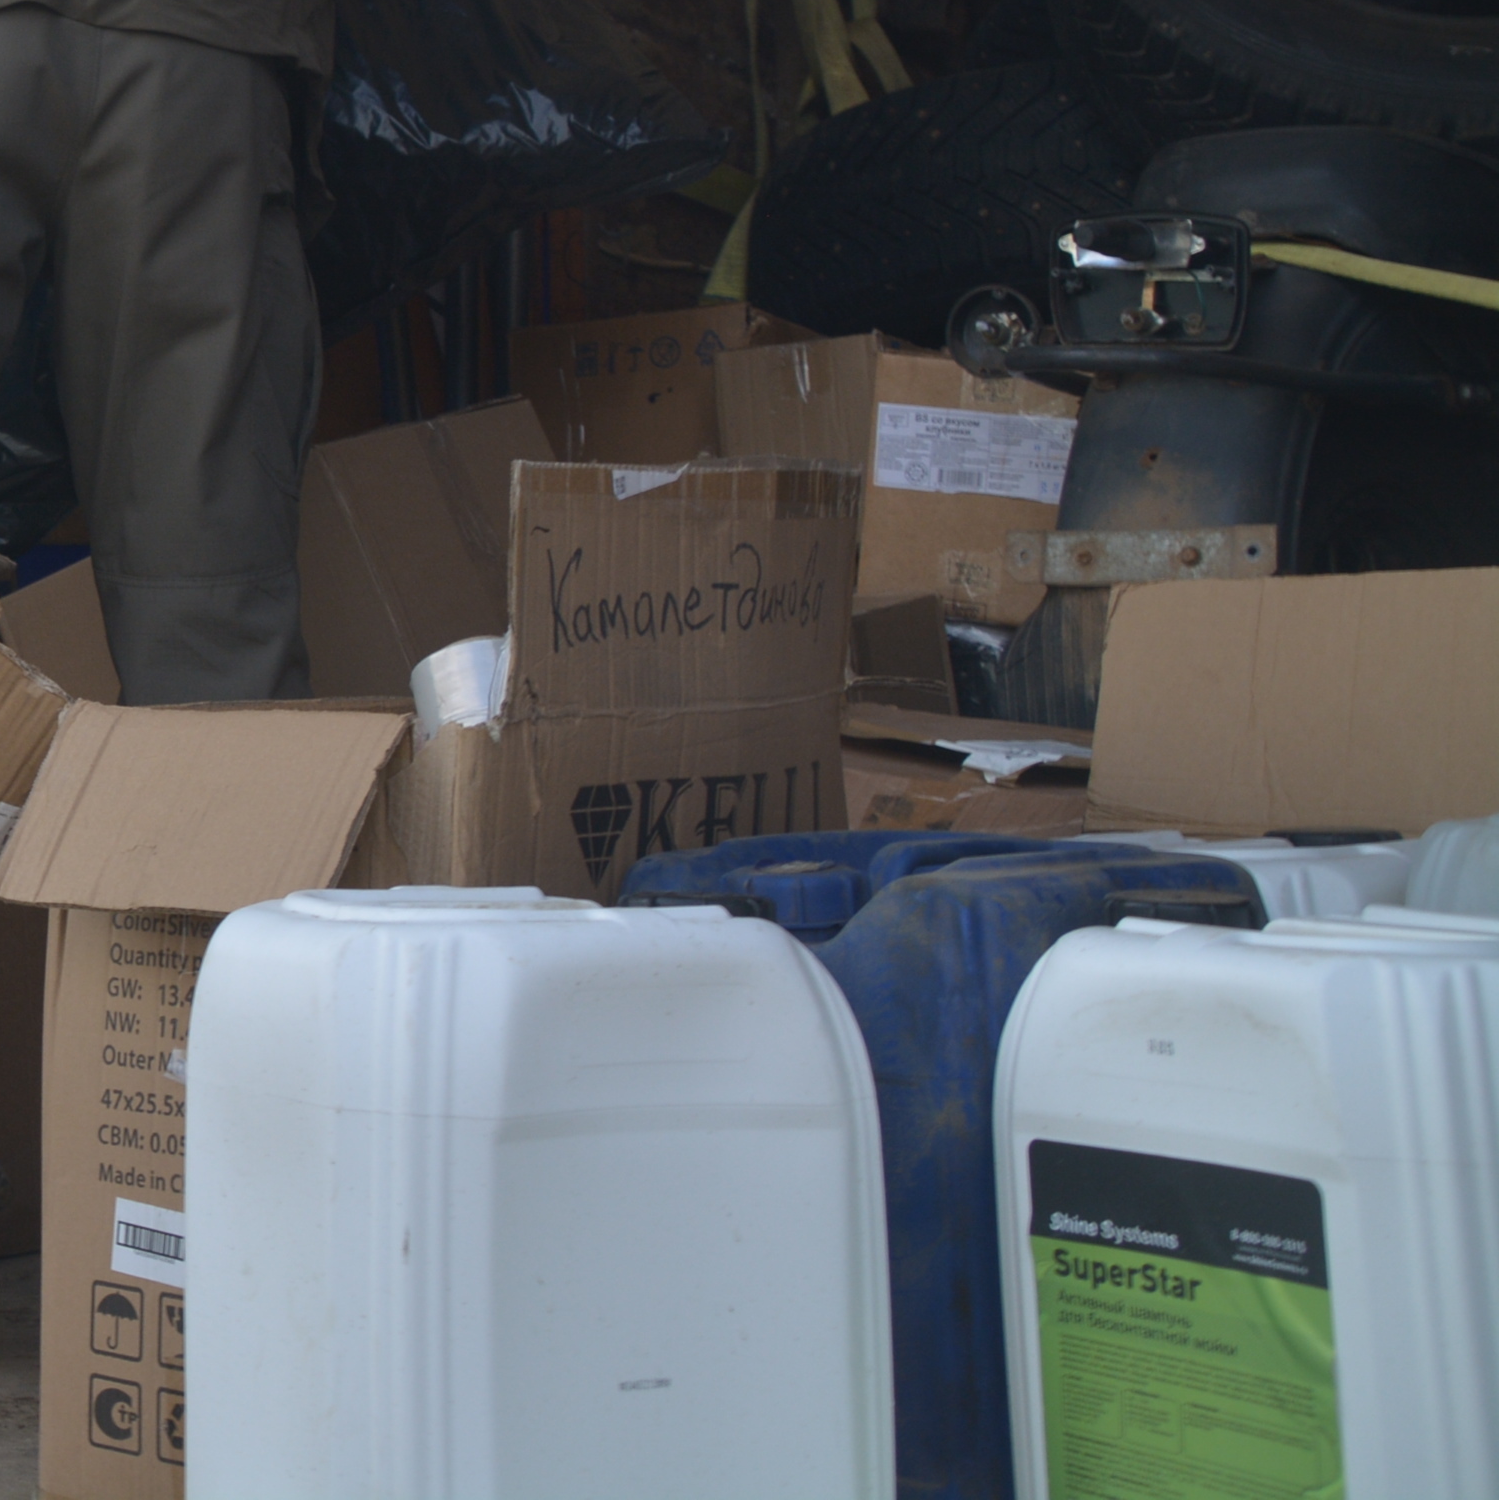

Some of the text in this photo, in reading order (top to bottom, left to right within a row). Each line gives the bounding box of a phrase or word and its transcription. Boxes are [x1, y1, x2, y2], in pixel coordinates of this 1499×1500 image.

[110, 942, 189, 975] Quantity
[107, 977, 143, 1000] GW:
[104, 1010, 190, 1041] NW: 11.
[103, 1044, 155, 1071] Outer
[97, 1123, 145, 1150] CBM:
[98, 1162, 147, 1187] Made
[150, 1170, 166, 1191] in
[1049, 1211, 1180, 1250] Shine Systems
[1054, 1248, 1202, 1301] SuperStar
